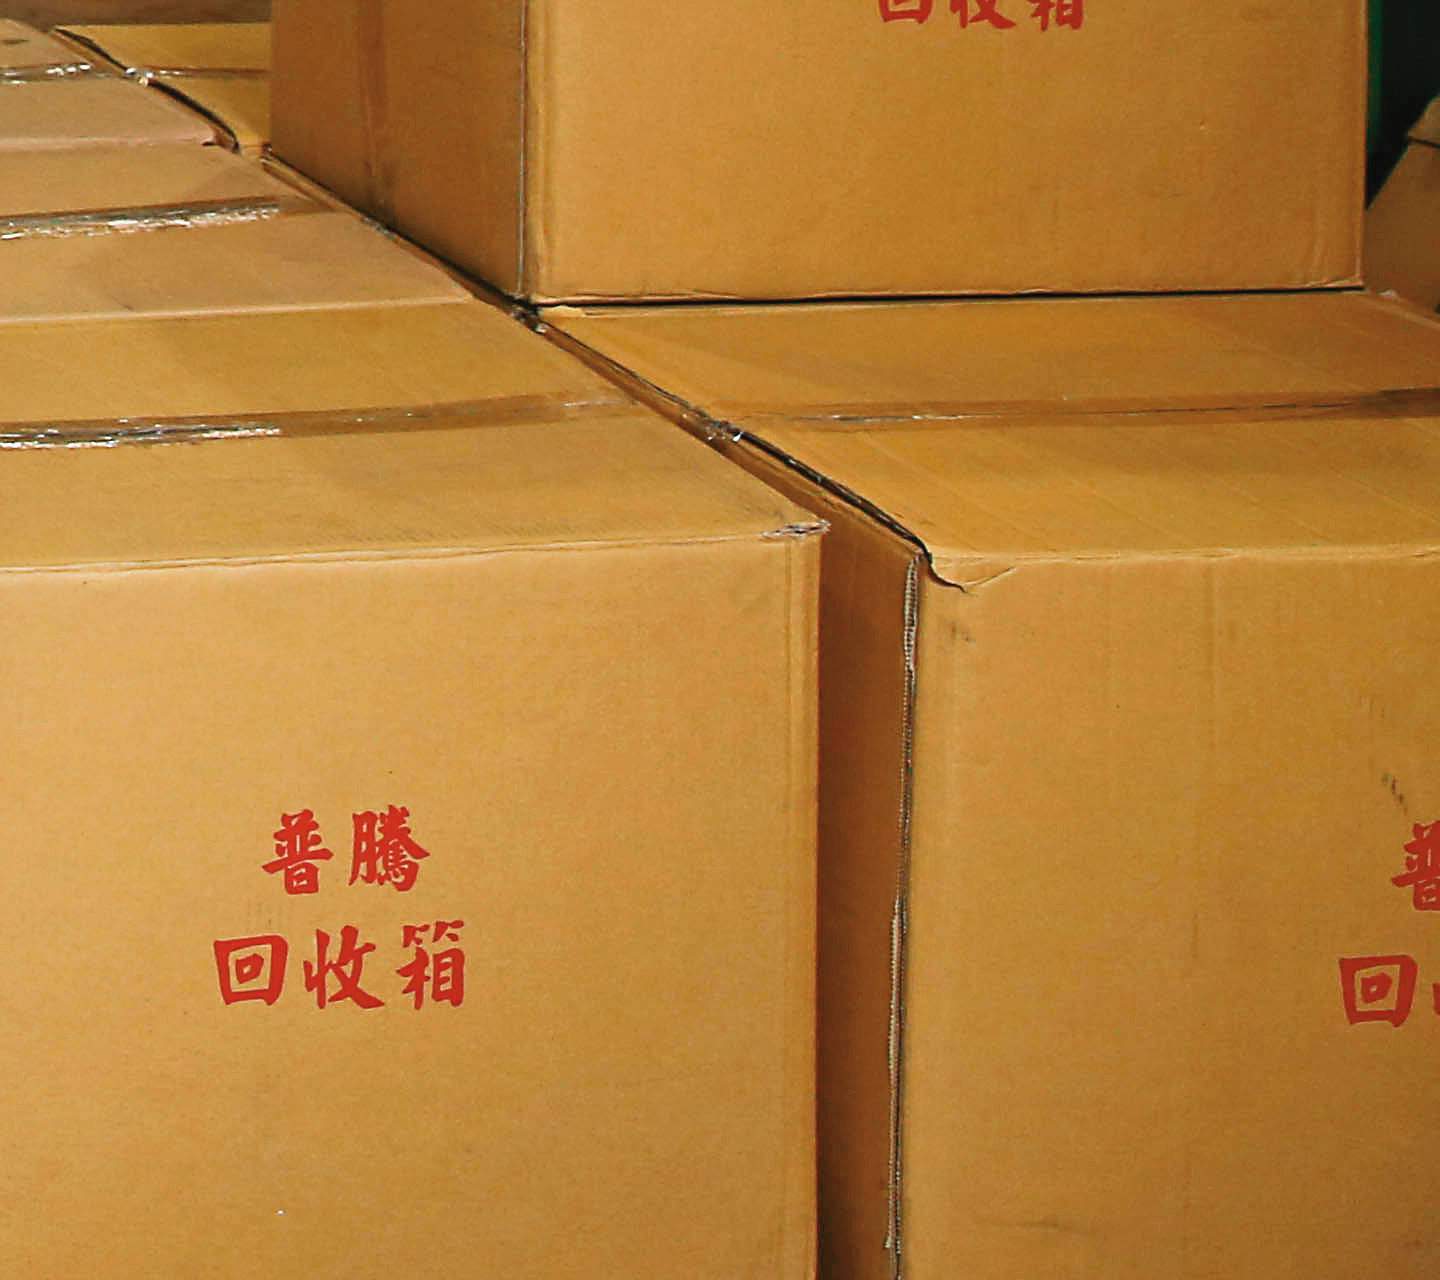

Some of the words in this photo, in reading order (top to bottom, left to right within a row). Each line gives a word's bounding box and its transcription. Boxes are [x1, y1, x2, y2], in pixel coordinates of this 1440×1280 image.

[261, 803, 431, 896] 普騰
[212, 919, 466, 1011] 回收箱
[1338, 953, 1440, 1029] 回
